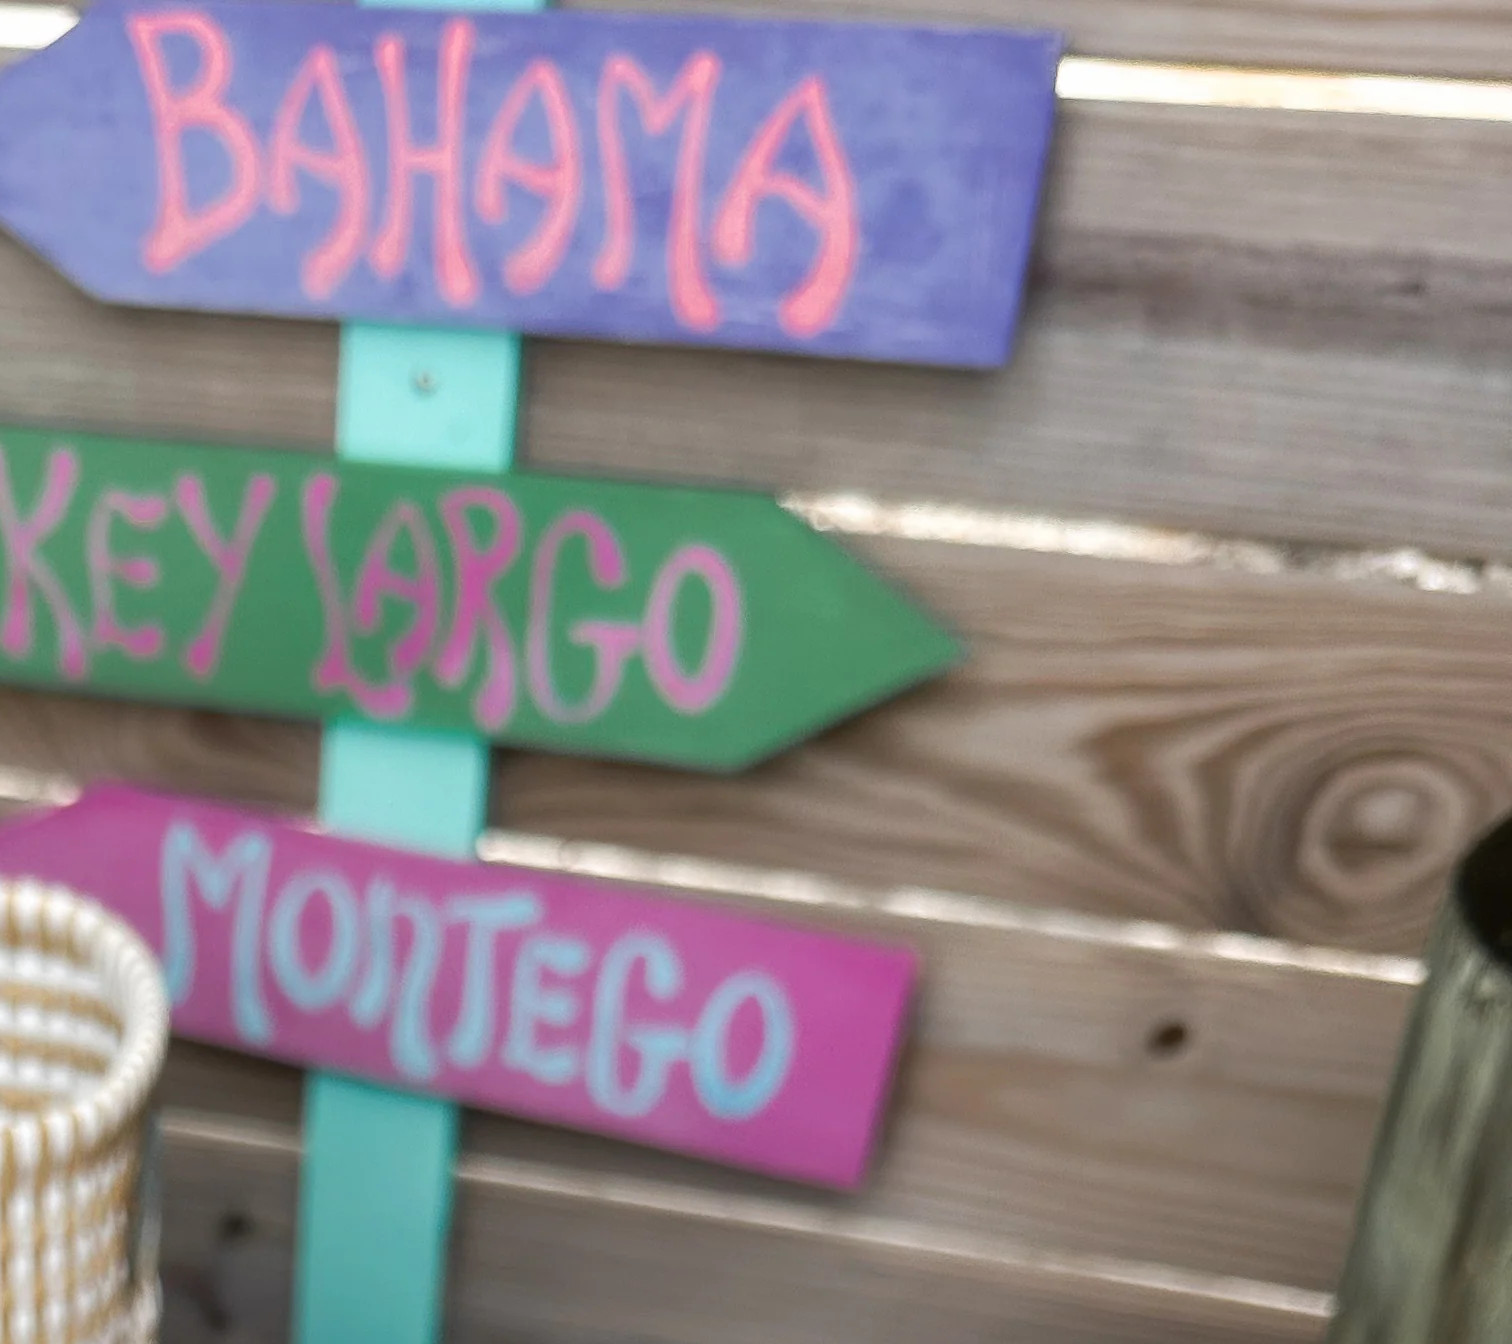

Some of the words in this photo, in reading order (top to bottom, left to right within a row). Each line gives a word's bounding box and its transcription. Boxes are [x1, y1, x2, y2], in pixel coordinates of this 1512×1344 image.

[128, 10, 858, 336] BAHAMA
[302, 473, 742, 729] LARGO
[159, 820, 793, 1120] MONTEGO
